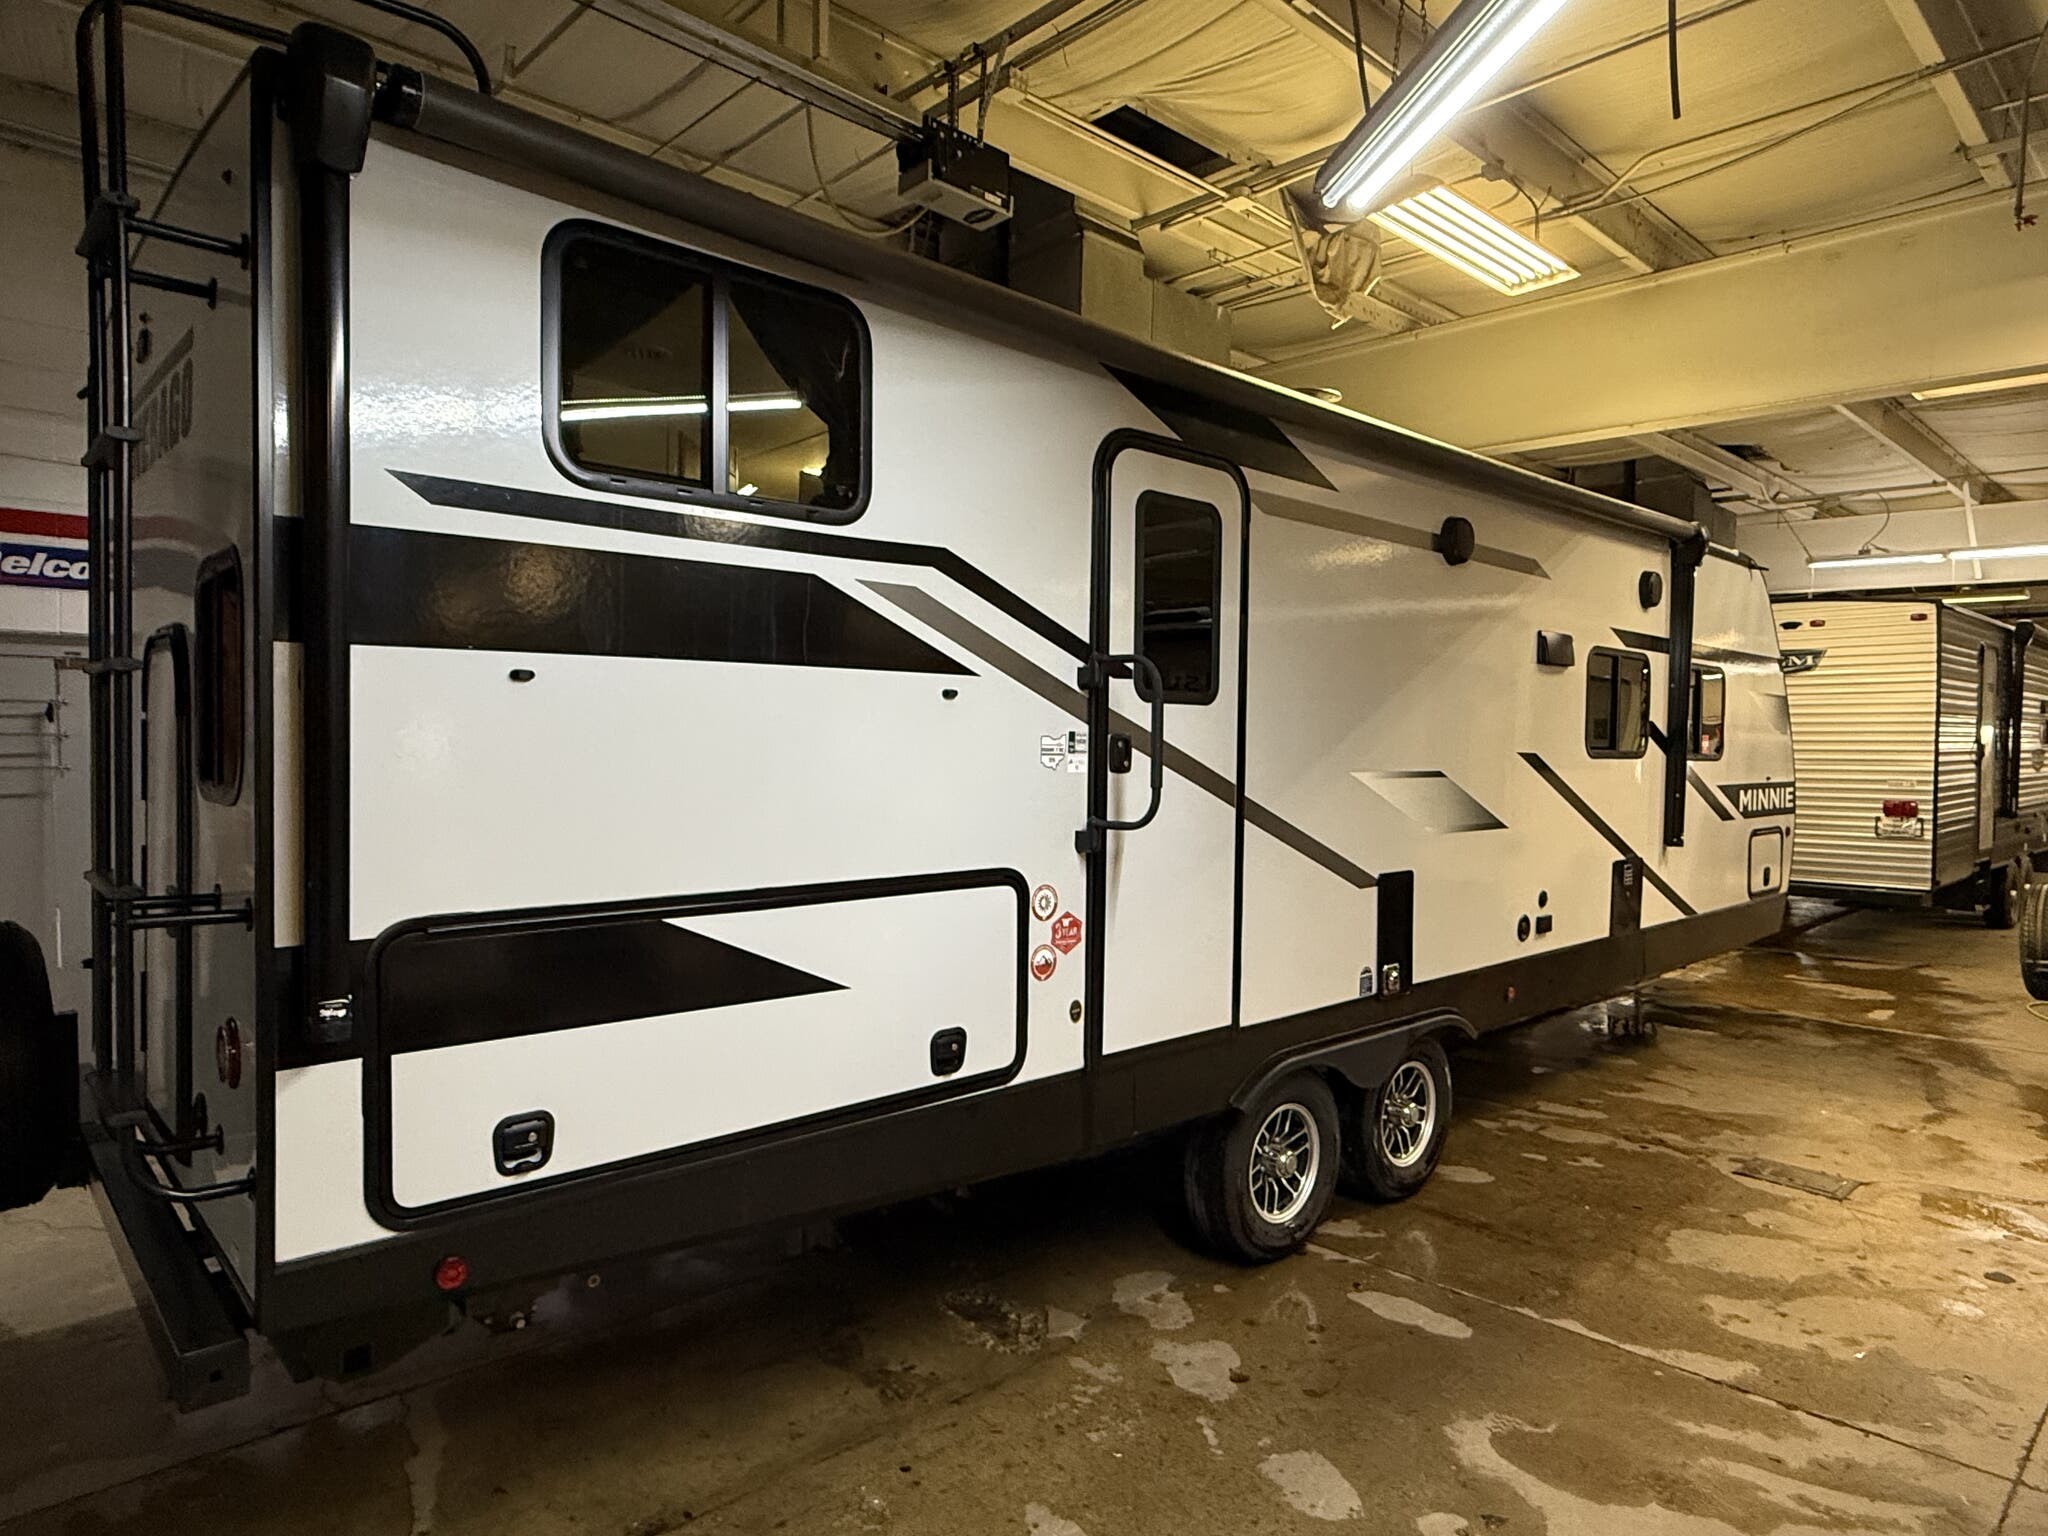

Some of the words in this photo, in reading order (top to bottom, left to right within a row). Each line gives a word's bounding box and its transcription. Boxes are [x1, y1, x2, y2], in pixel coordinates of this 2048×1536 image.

[0, 551, 89, 580] elco
[1739, 786, 1794, 812] MINNIE
[1054, 922, 1062, 939] 3
[1062, 926, 1078, 938] YEAR
